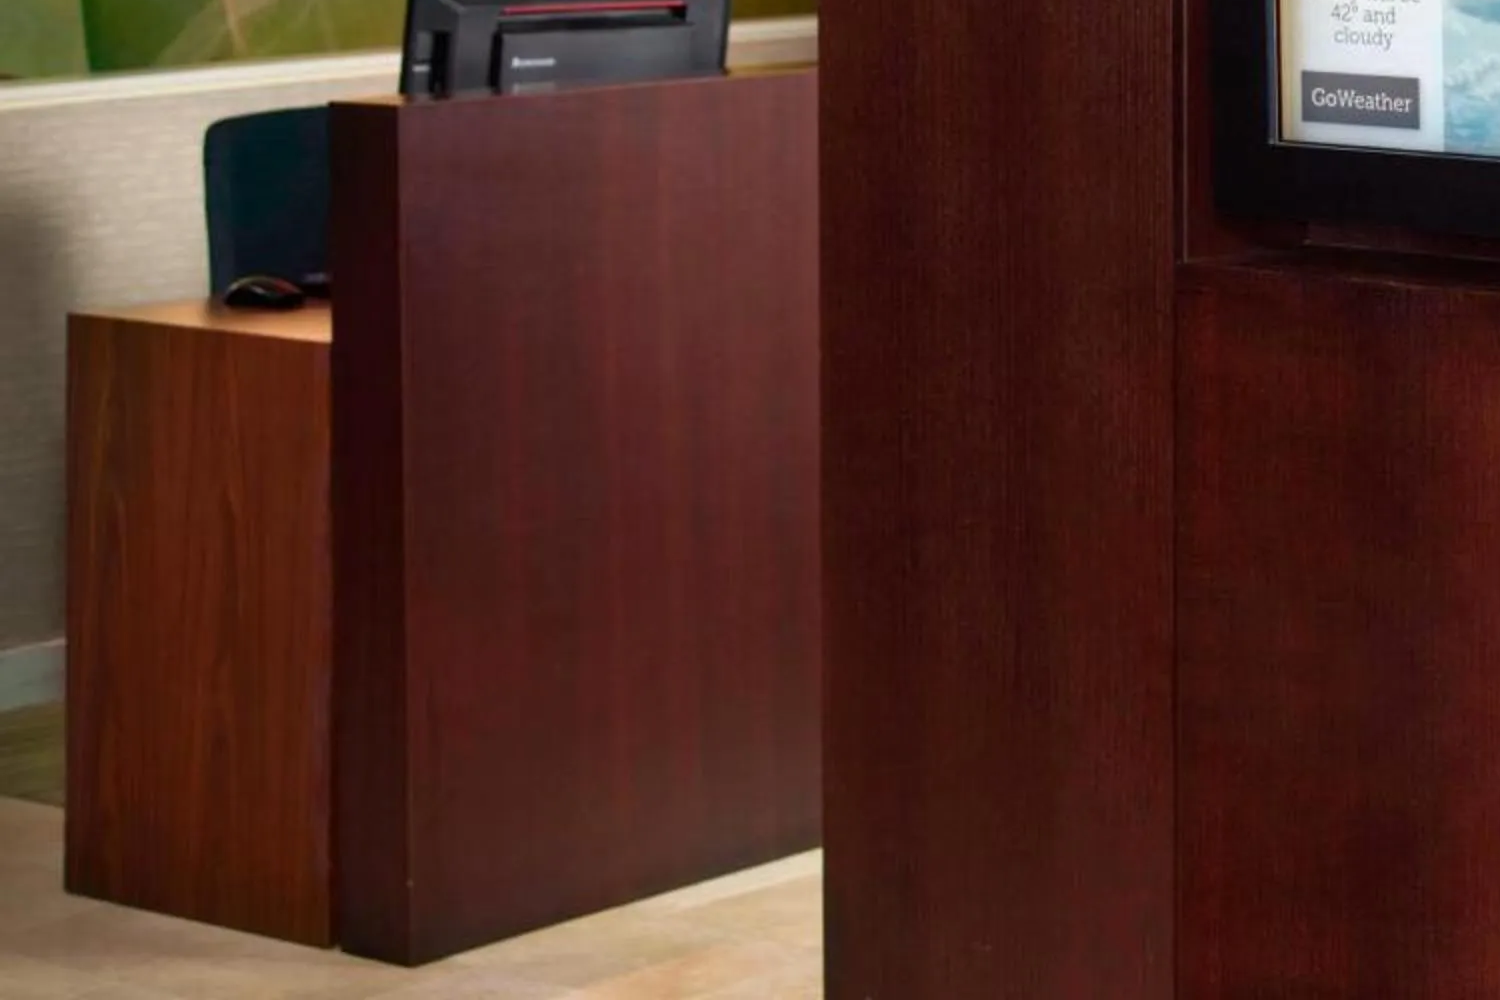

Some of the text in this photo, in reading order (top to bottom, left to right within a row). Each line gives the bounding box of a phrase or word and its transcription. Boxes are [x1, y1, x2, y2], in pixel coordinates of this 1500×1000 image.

[1330, 4, 1397, 25] 42° and
[1333, 27, 1393, 51] cloudy
[1311, 88, 1413, 113] GoWeather
